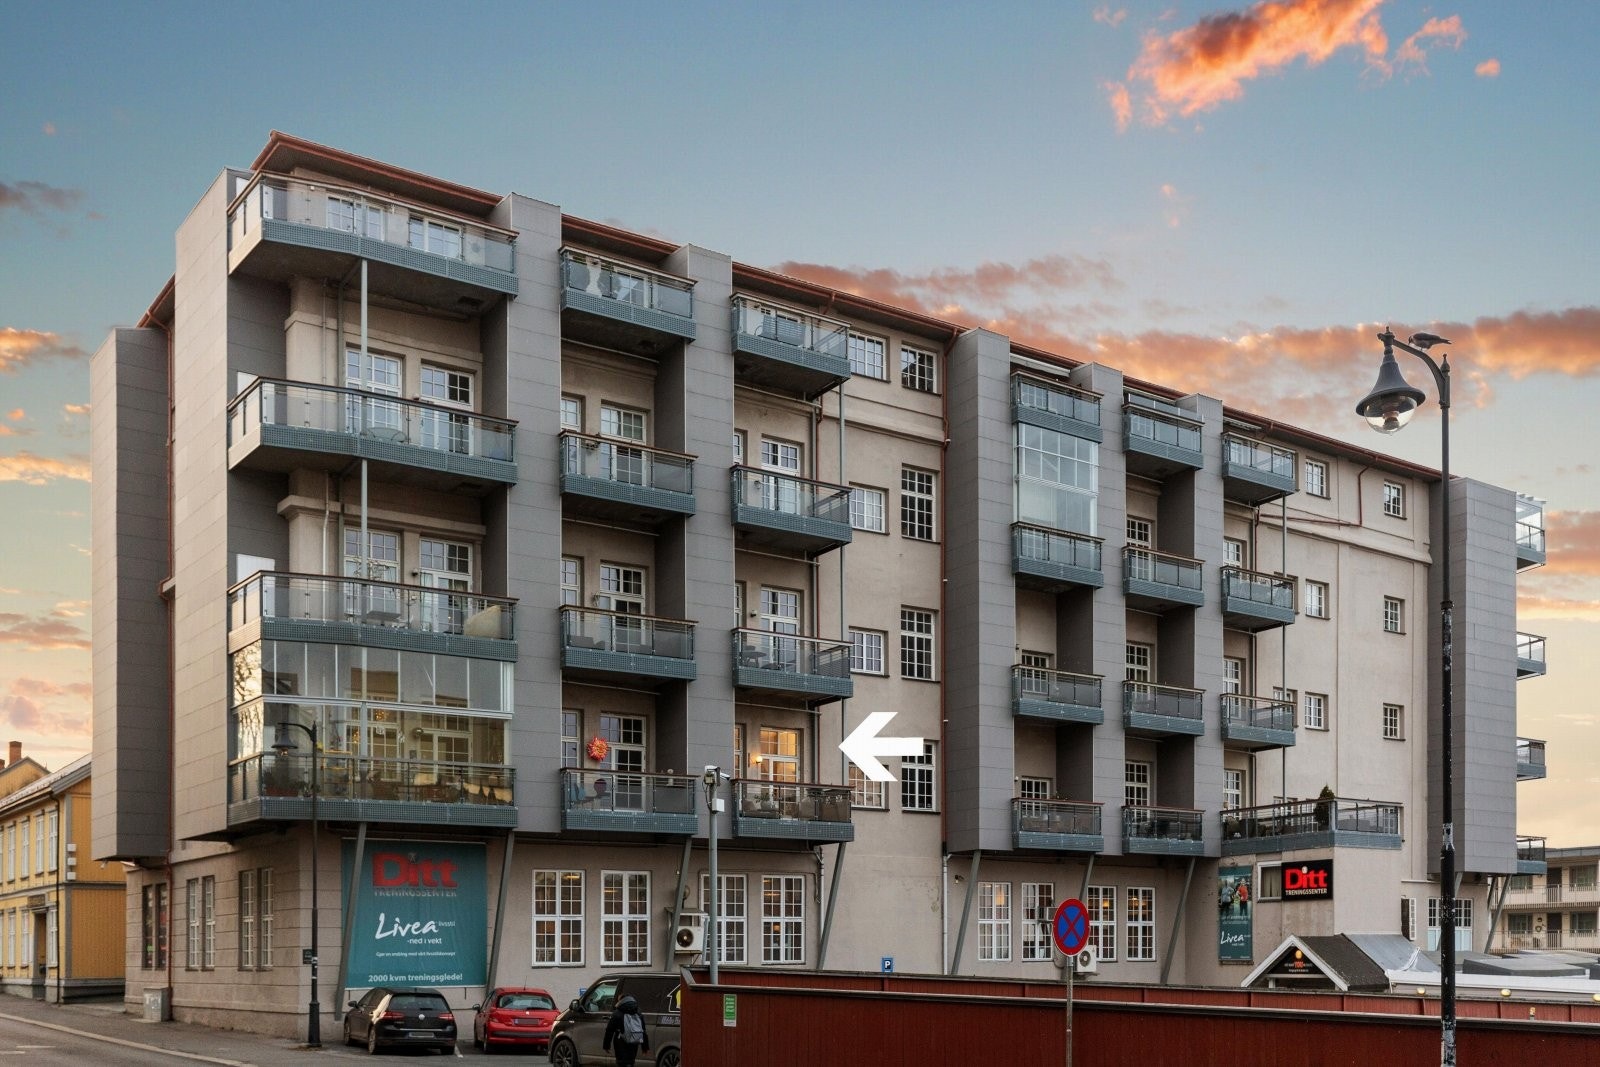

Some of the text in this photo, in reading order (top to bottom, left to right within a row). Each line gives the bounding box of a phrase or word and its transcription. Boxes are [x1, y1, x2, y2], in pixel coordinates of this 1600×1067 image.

[373, 852, 458, 887] Ditt
[1285, 866, 1328, 889] Ditt
[1285, 888, 1328, 896] TRENINGSSENTER
[375, 912, 439, 940] Livea
[1220, 930, 1244, 945] Livea
[368, 973, 463, 982] 2000 kvm treningsglede!
